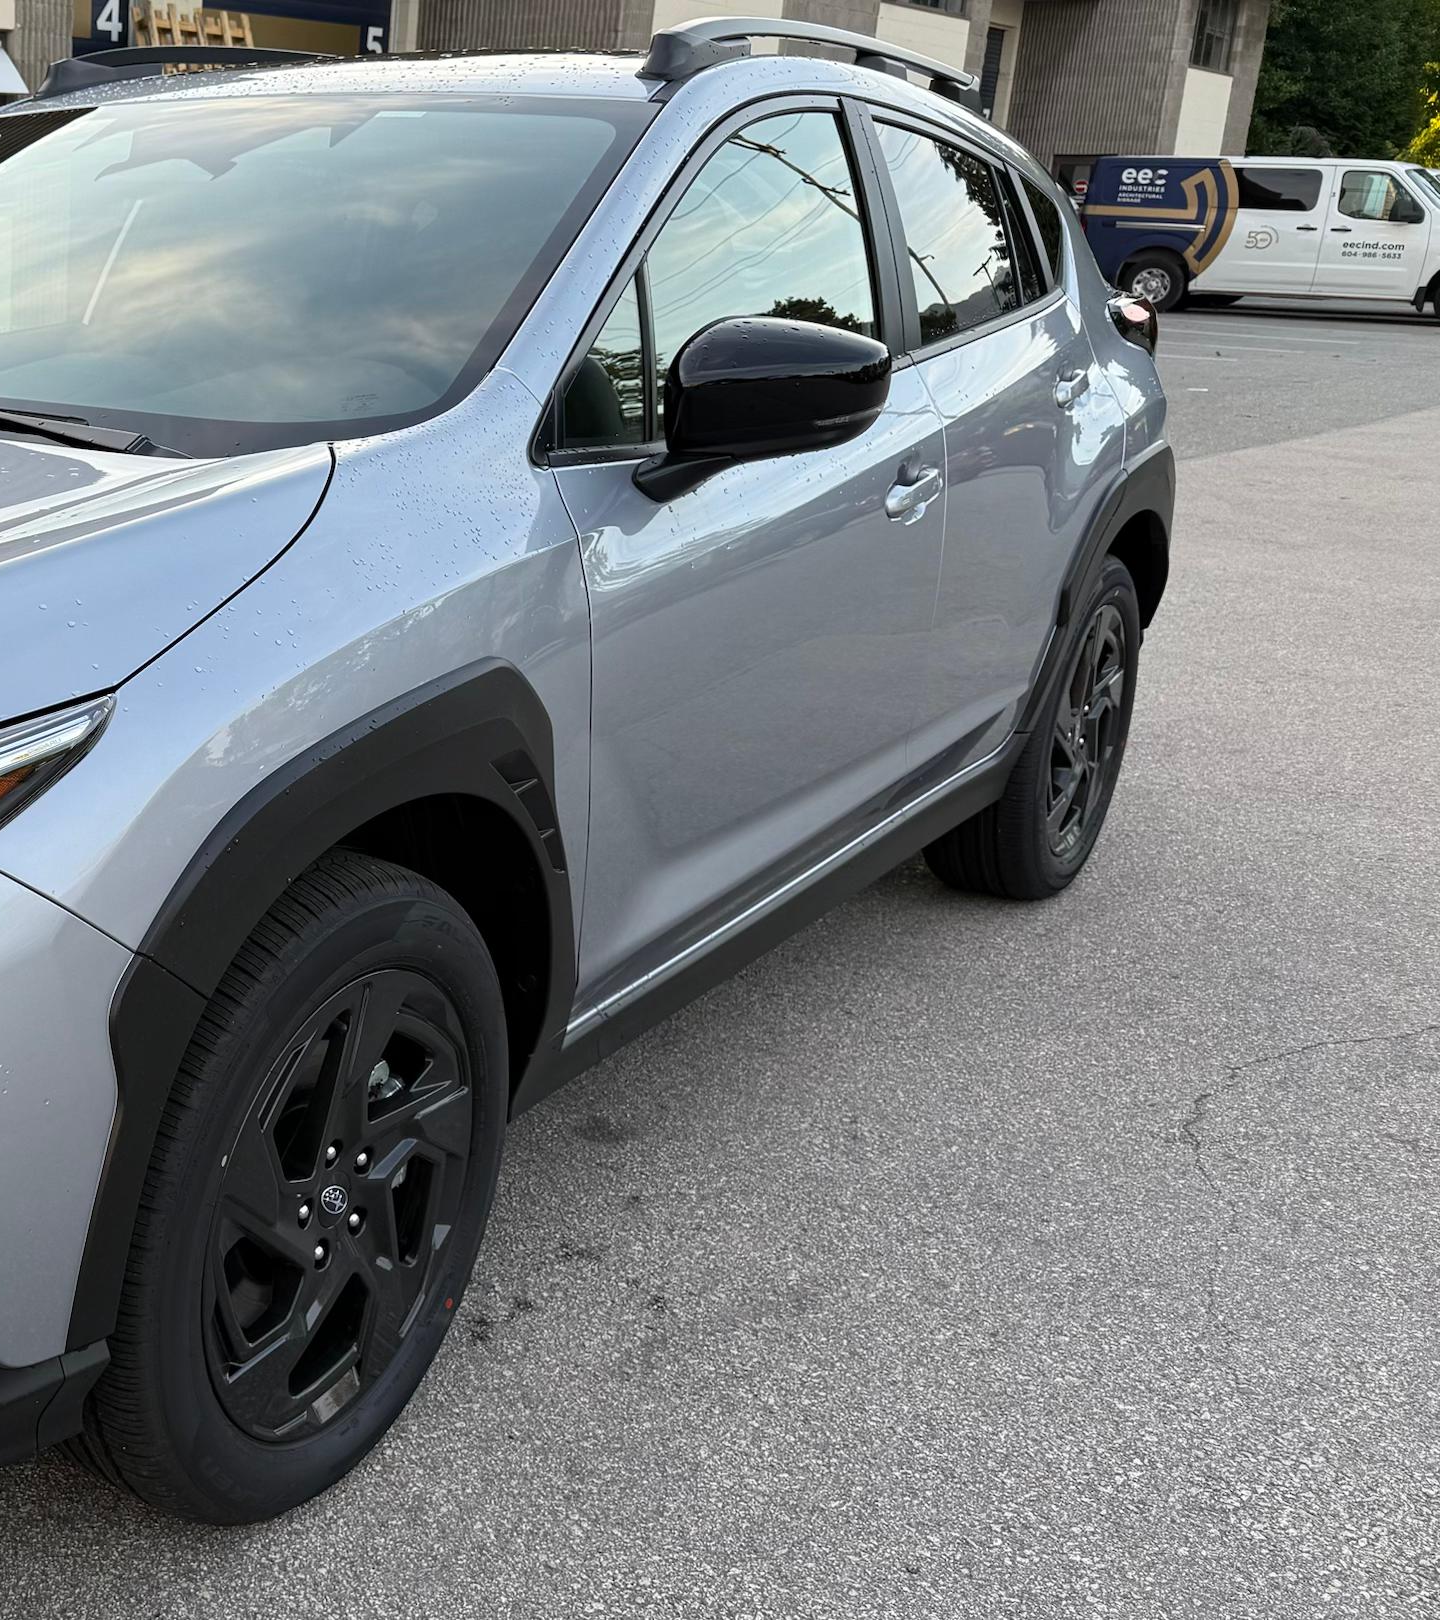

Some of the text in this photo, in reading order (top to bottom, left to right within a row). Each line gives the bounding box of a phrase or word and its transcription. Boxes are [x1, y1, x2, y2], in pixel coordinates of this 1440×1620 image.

[96, 0, 122, 42] 4
[366, 26, 383, 54] 5
[1121, 168, 1168, 184] eec
[1119, 184, 1165, 193] INDUSTRIES
[1342, 241, 1405, 250] eecind.com
